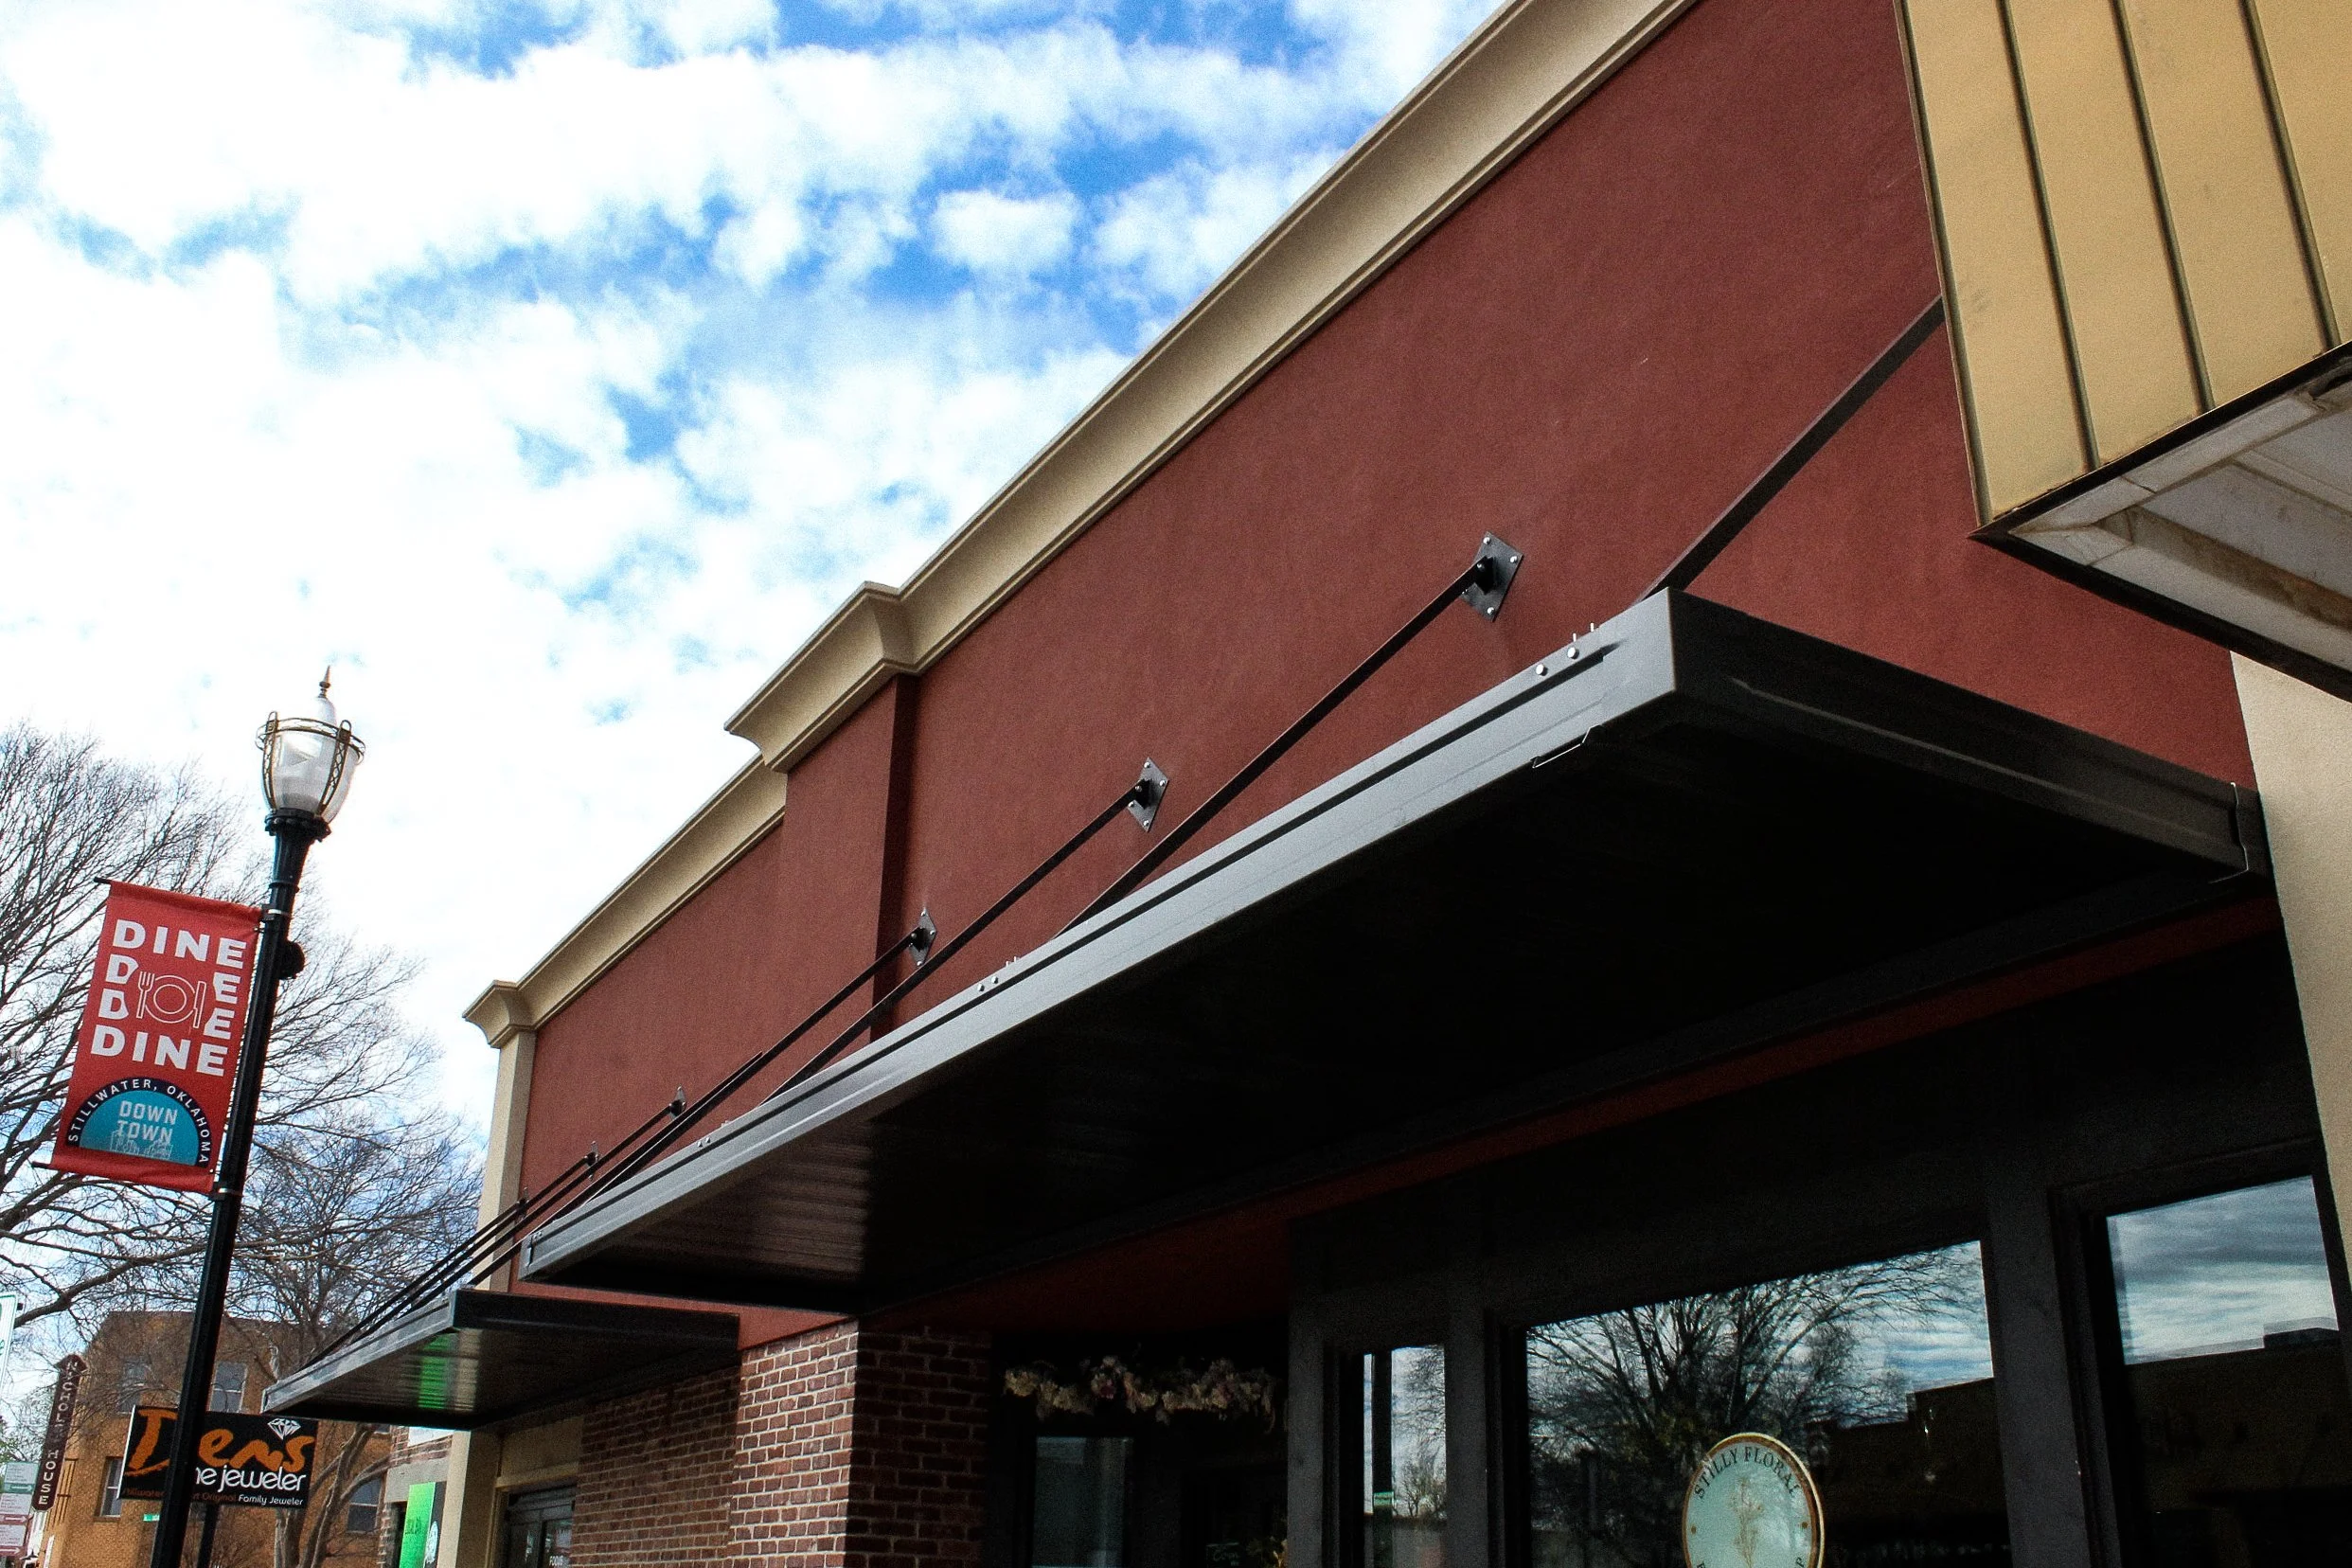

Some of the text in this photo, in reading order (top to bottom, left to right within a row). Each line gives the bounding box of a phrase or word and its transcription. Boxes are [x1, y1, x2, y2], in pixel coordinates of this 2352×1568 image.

[113, 918, 247, 970] DINE
[90, 1025, 229, 1077] DINE
[116, 1120, 173, 1144] TOWN
[119, 1100, 178, 1125] DOWN
[167, 1085, 211, 1163] OKLAHOMA
[39, 1450, 59, 1505] HOUSE
[217, 1464, 307, 1493] jeweler
[1694, 1446, 1800, 1500] STILLY FLORAL
[238, 1493, 268, 1506] Family
[269, 1496, 304, 1506] Jeweler
